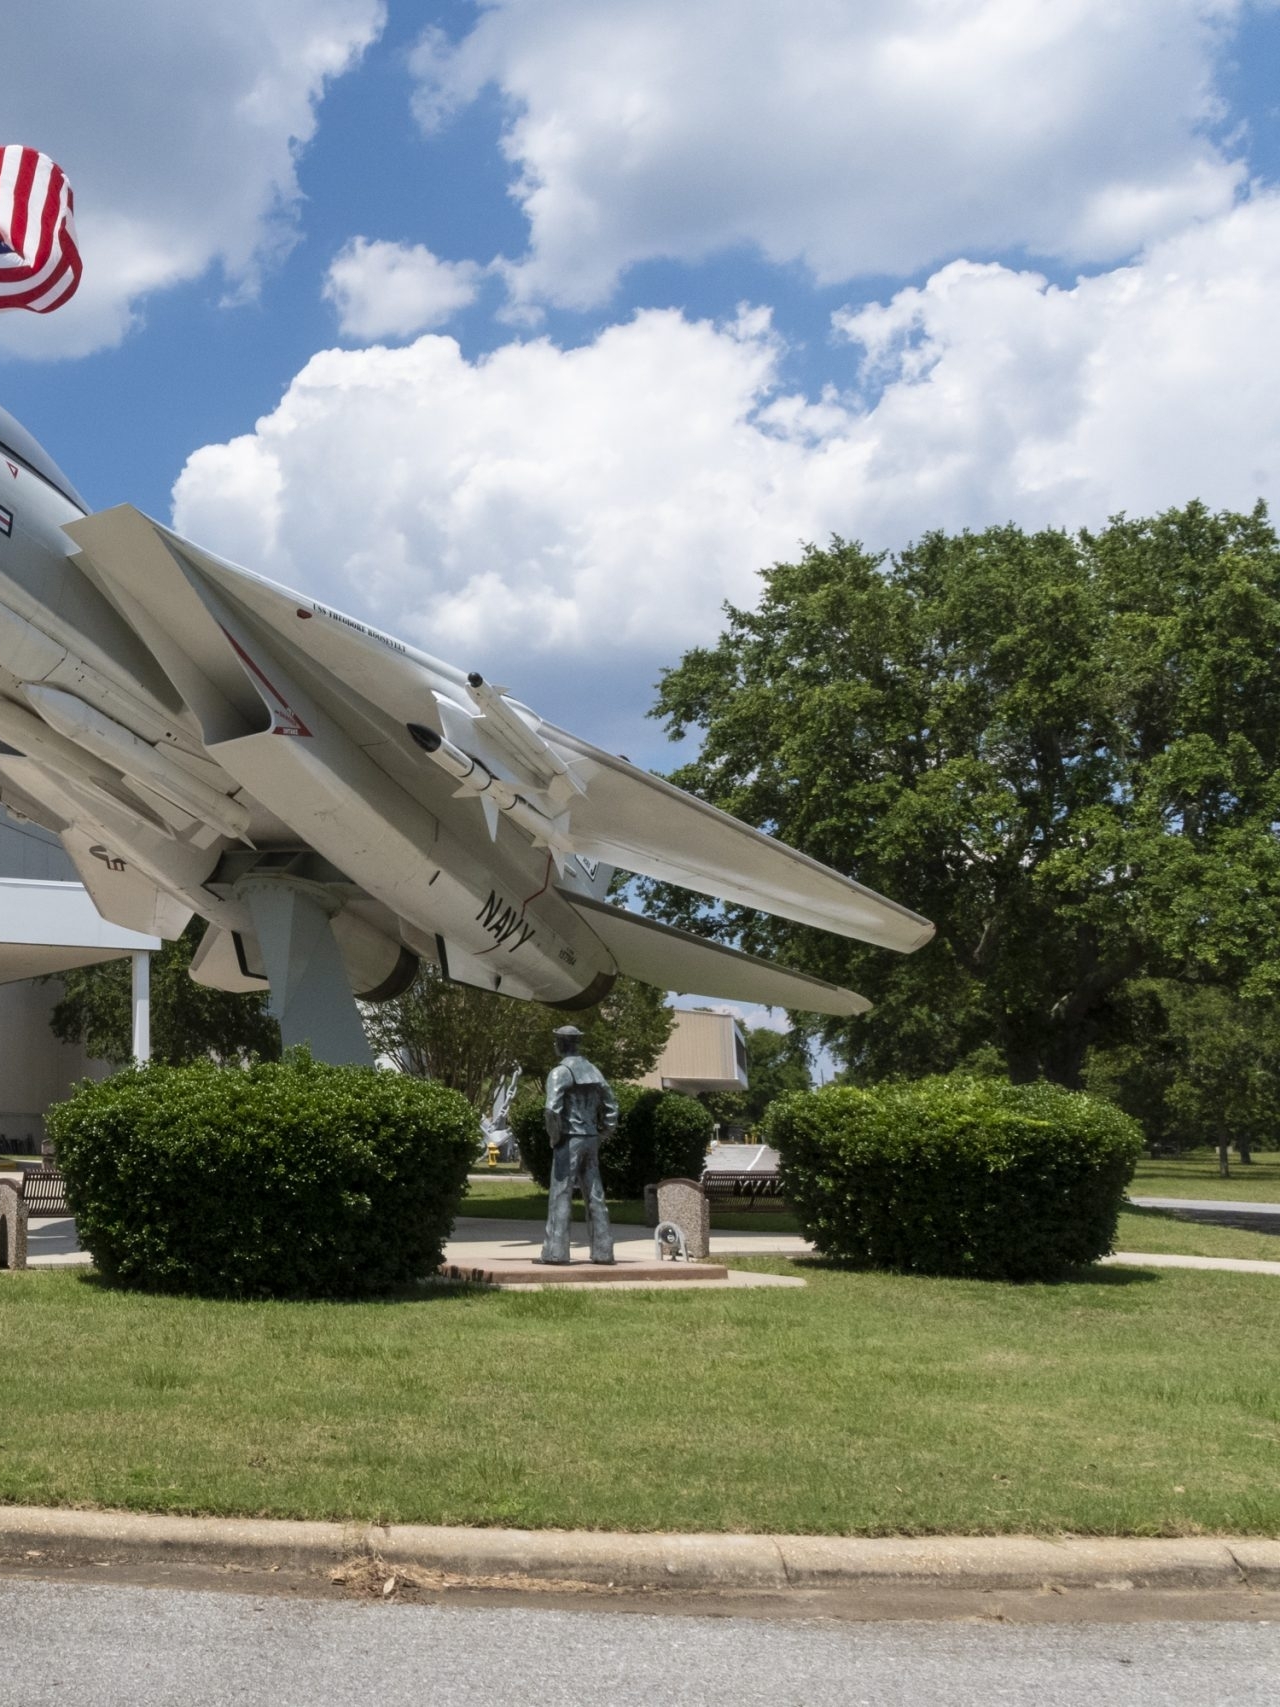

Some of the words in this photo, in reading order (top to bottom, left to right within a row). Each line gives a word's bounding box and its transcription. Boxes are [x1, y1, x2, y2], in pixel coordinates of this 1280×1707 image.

[312, 603, 327, 616] USS
[328, 611, 367, 634] THEODORE
[367, 629, 407, 654] ROOSEVELT
[475, 889, 536, 953] NAVY
